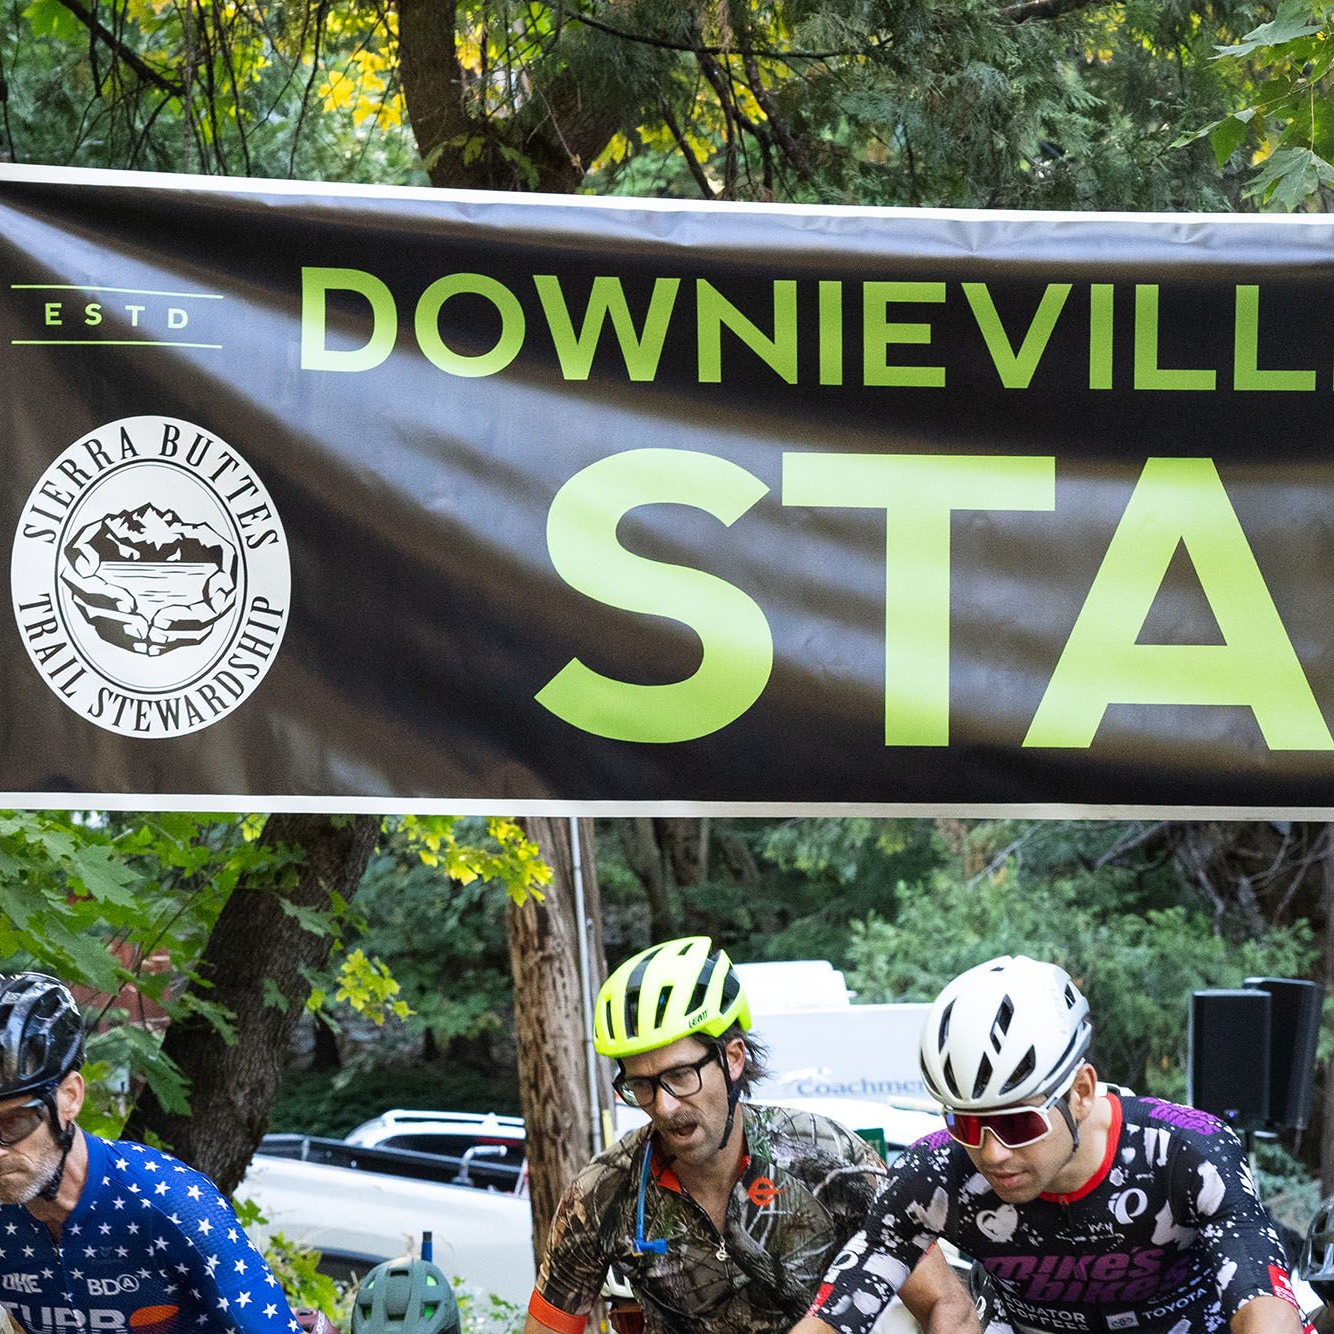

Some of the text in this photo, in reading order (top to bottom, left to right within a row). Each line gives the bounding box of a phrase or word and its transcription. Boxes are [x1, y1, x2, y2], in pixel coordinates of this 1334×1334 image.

[22, 423, 280, 550] SIERRA BUTTES
[18, 592, 285, 733] TRAIL STEWARDSHIP
[1142, 1287, 1208, 1321] TOYOTA
